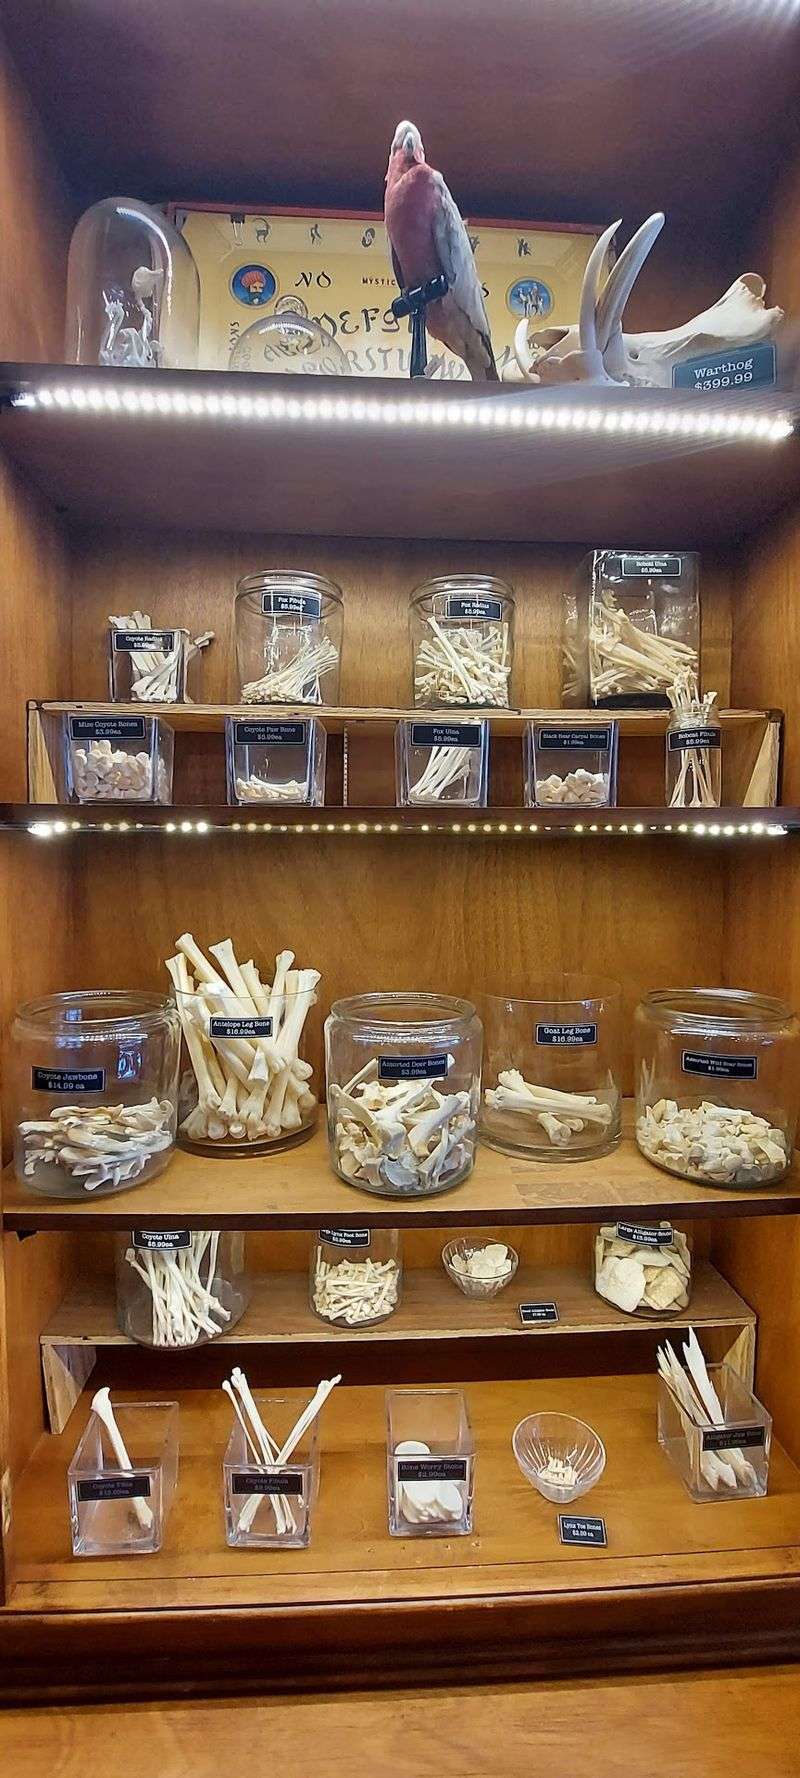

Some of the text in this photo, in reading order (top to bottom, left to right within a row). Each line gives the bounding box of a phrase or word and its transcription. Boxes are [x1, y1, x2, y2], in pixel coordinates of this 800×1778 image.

[694, 358, 754, 379] Warthog
[694, 372, 753, 391] $399.99
[95, 721, 118, 729] Coyote
[244, 726, 265, 734] Coyote
[213, 1021, 241, 1029] Antelope
[242, 1021, 254, 1029] Leg
[38, 1071, 61, 1081] Coyote
[142, 1233, 163, 1241] Coyote
